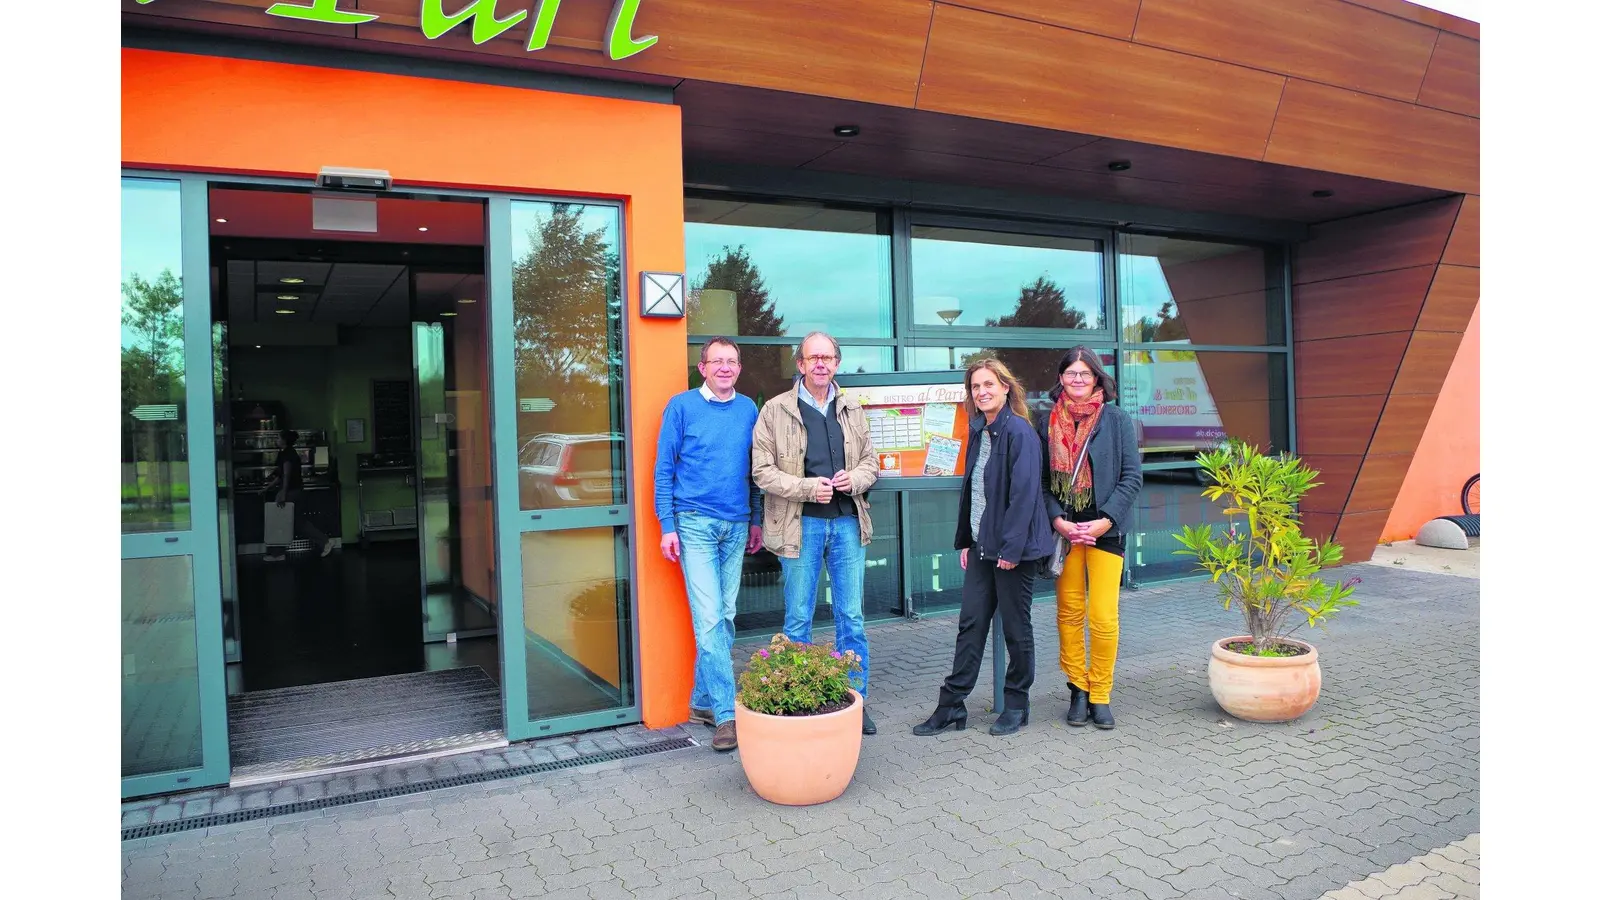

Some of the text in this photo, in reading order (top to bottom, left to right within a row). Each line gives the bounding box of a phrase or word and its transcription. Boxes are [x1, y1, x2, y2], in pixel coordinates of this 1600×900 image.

[884, 386, 966, 403] BISTRO al Pari
